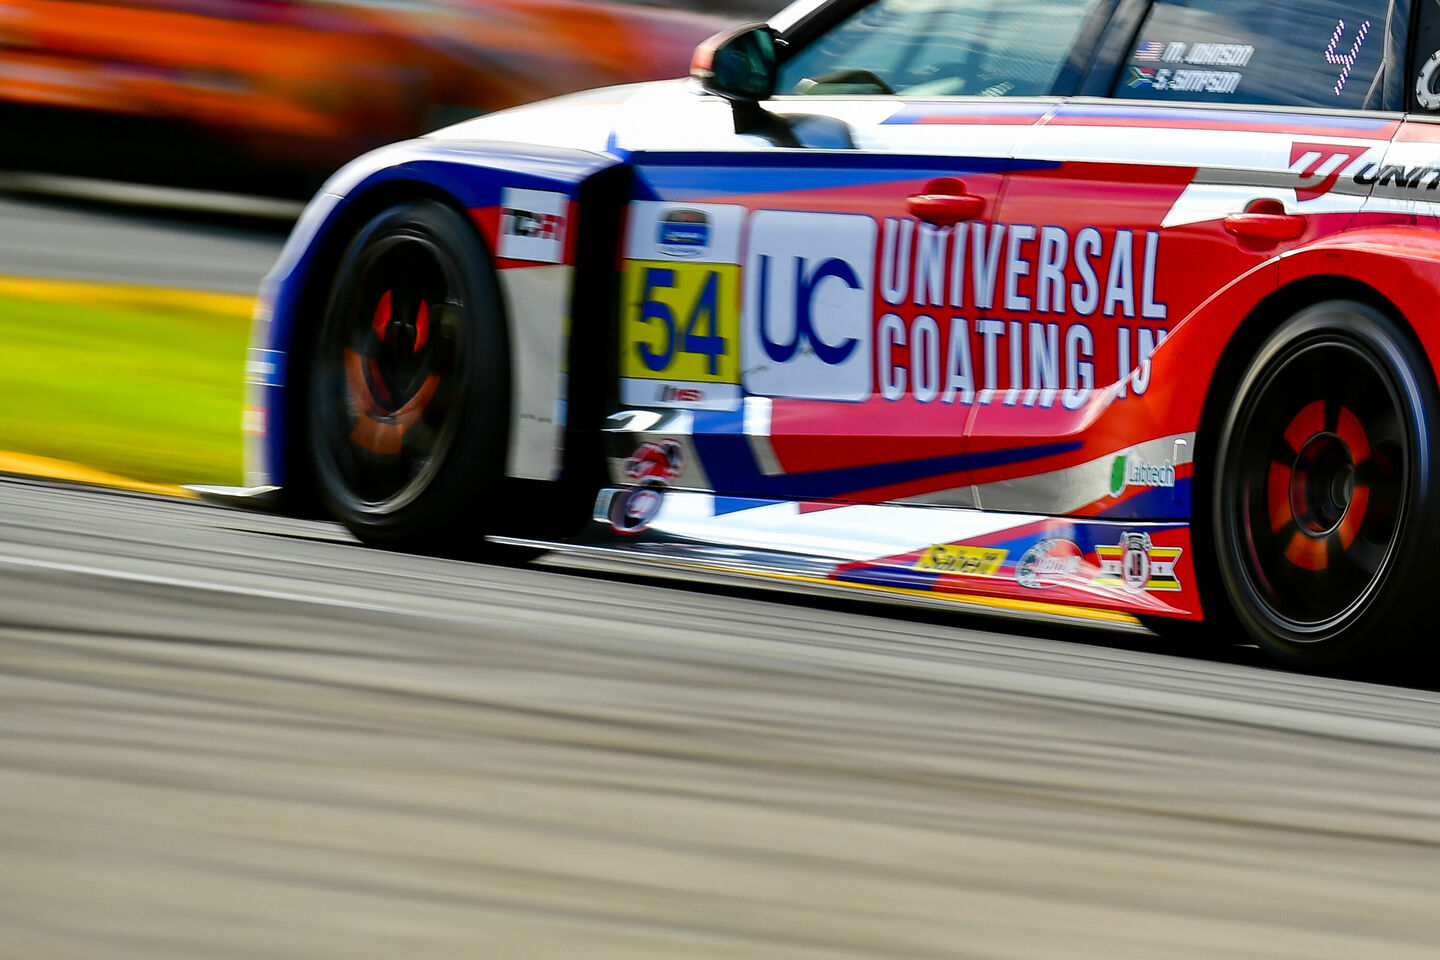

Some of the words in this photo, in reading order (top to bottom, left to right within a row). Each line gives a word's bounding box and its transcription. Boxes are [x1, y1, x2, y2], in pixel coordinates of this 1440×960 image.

[757, 254, 864, 365] UC
[879, 216, 1169, 319] UNIVERSAL
[640, 268, 728, 376] 54
[877, 312, 1096, 411] COATING
